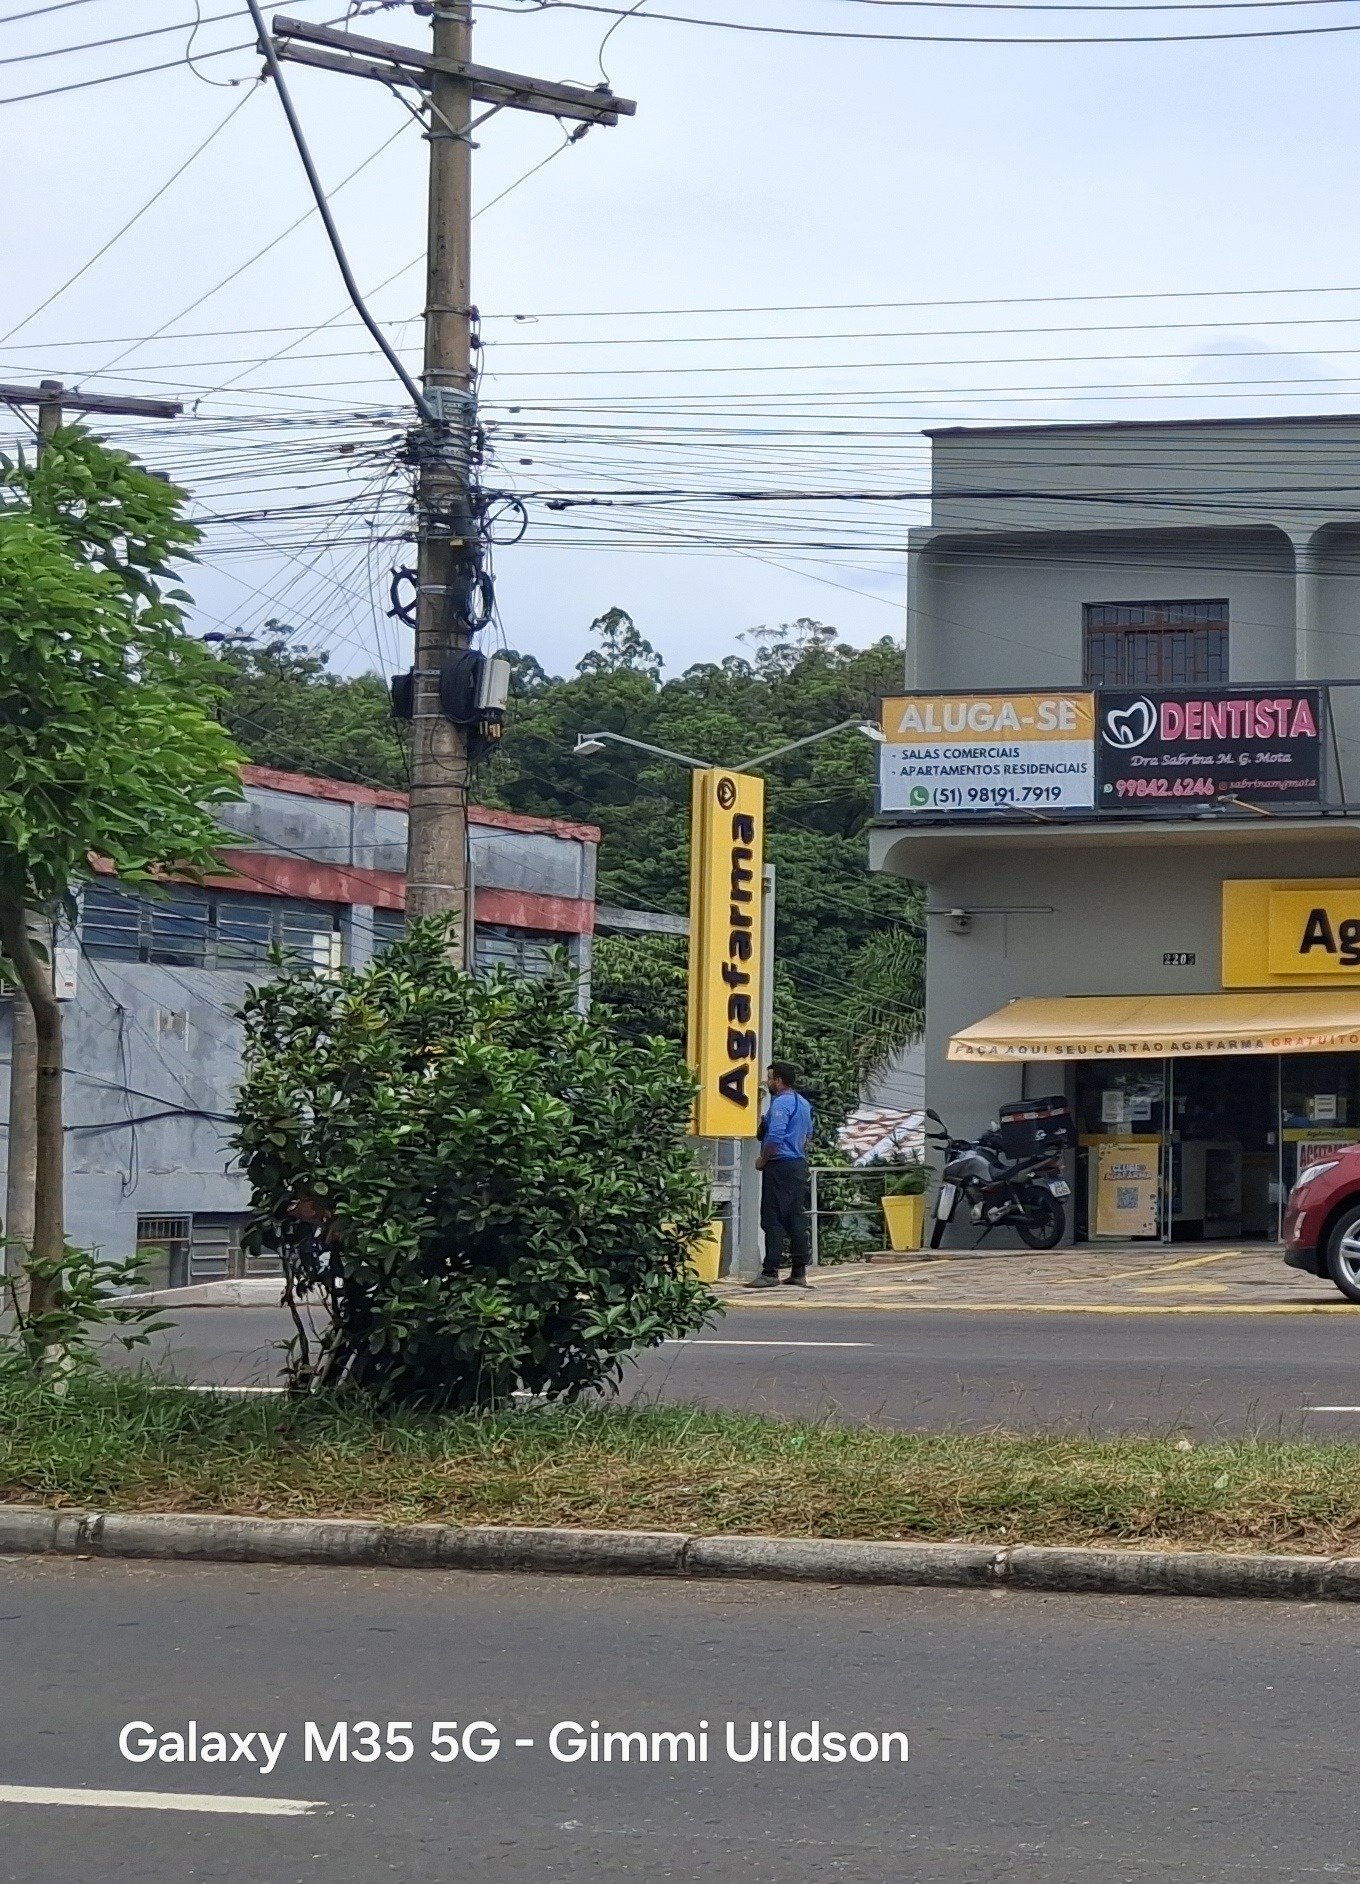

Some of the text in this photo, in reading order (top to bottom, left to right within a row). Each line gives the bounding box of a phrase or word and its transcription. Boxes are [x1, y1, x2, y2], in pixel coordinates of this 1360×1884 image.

[898, 700, 1077, 733] ALUGA-SE
[1160, 699, 1316, 741] DENTISTA
[902, 748, 1020, 759] SALAS COMERCIAIS
[1131, 755, 1158, 767] Dra
[1161, 753, 1214, 767] Sabrina
[1255, 752, 1292, 763] Mota
[900, 763, 1087, 776] APARTAMENTOS RESIDENCIAIS
[933, 786, 1062, 806] (51) 98191.7919
[1116, 778, 1214, 797] 99842.6246
[719, 812, 757, 1110] Agafarma
[1004, 1045, 1048, 1056] AQUI
[1055, 1044, 1088, 1055] SEU
[1094, 1040, 1164, 1054] CARTÃO
[1171, 1039, 1264, 1052] AGAFARMA
[1272, 1033, 1360, 1048] GRATUITO
